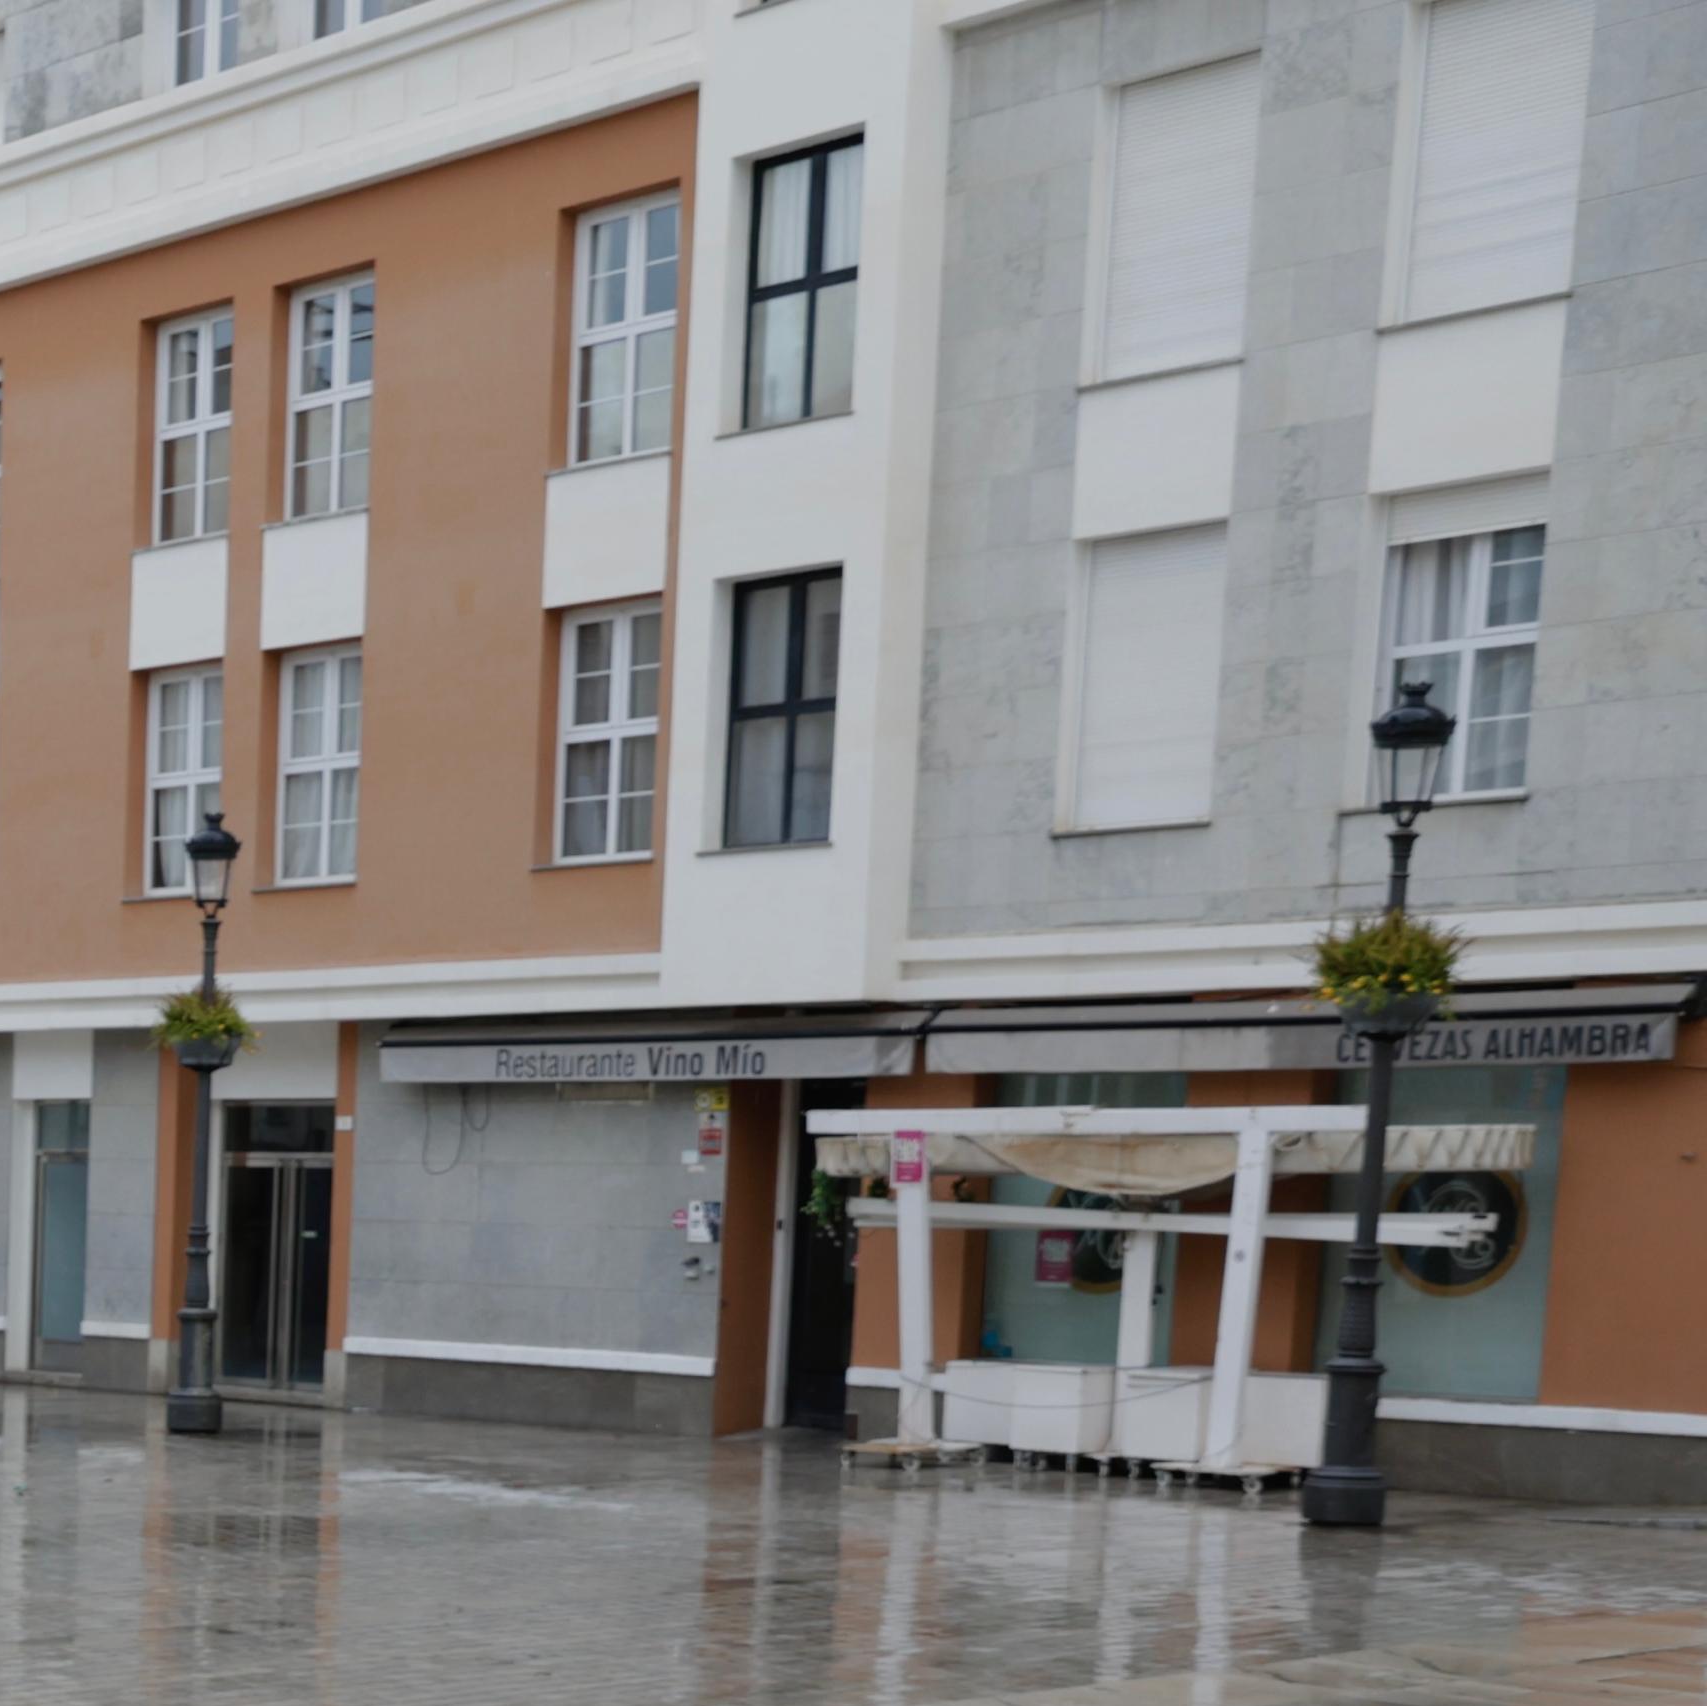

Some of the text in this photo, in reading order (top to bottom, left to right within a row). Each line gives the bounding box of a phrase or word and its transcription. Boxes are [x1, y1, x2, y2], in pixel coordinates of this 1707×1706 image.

[1482, 1023, 1651, 1060] ALHAMBRA
[495, 1043, 766, 1078] Restaurante Vino Mío
